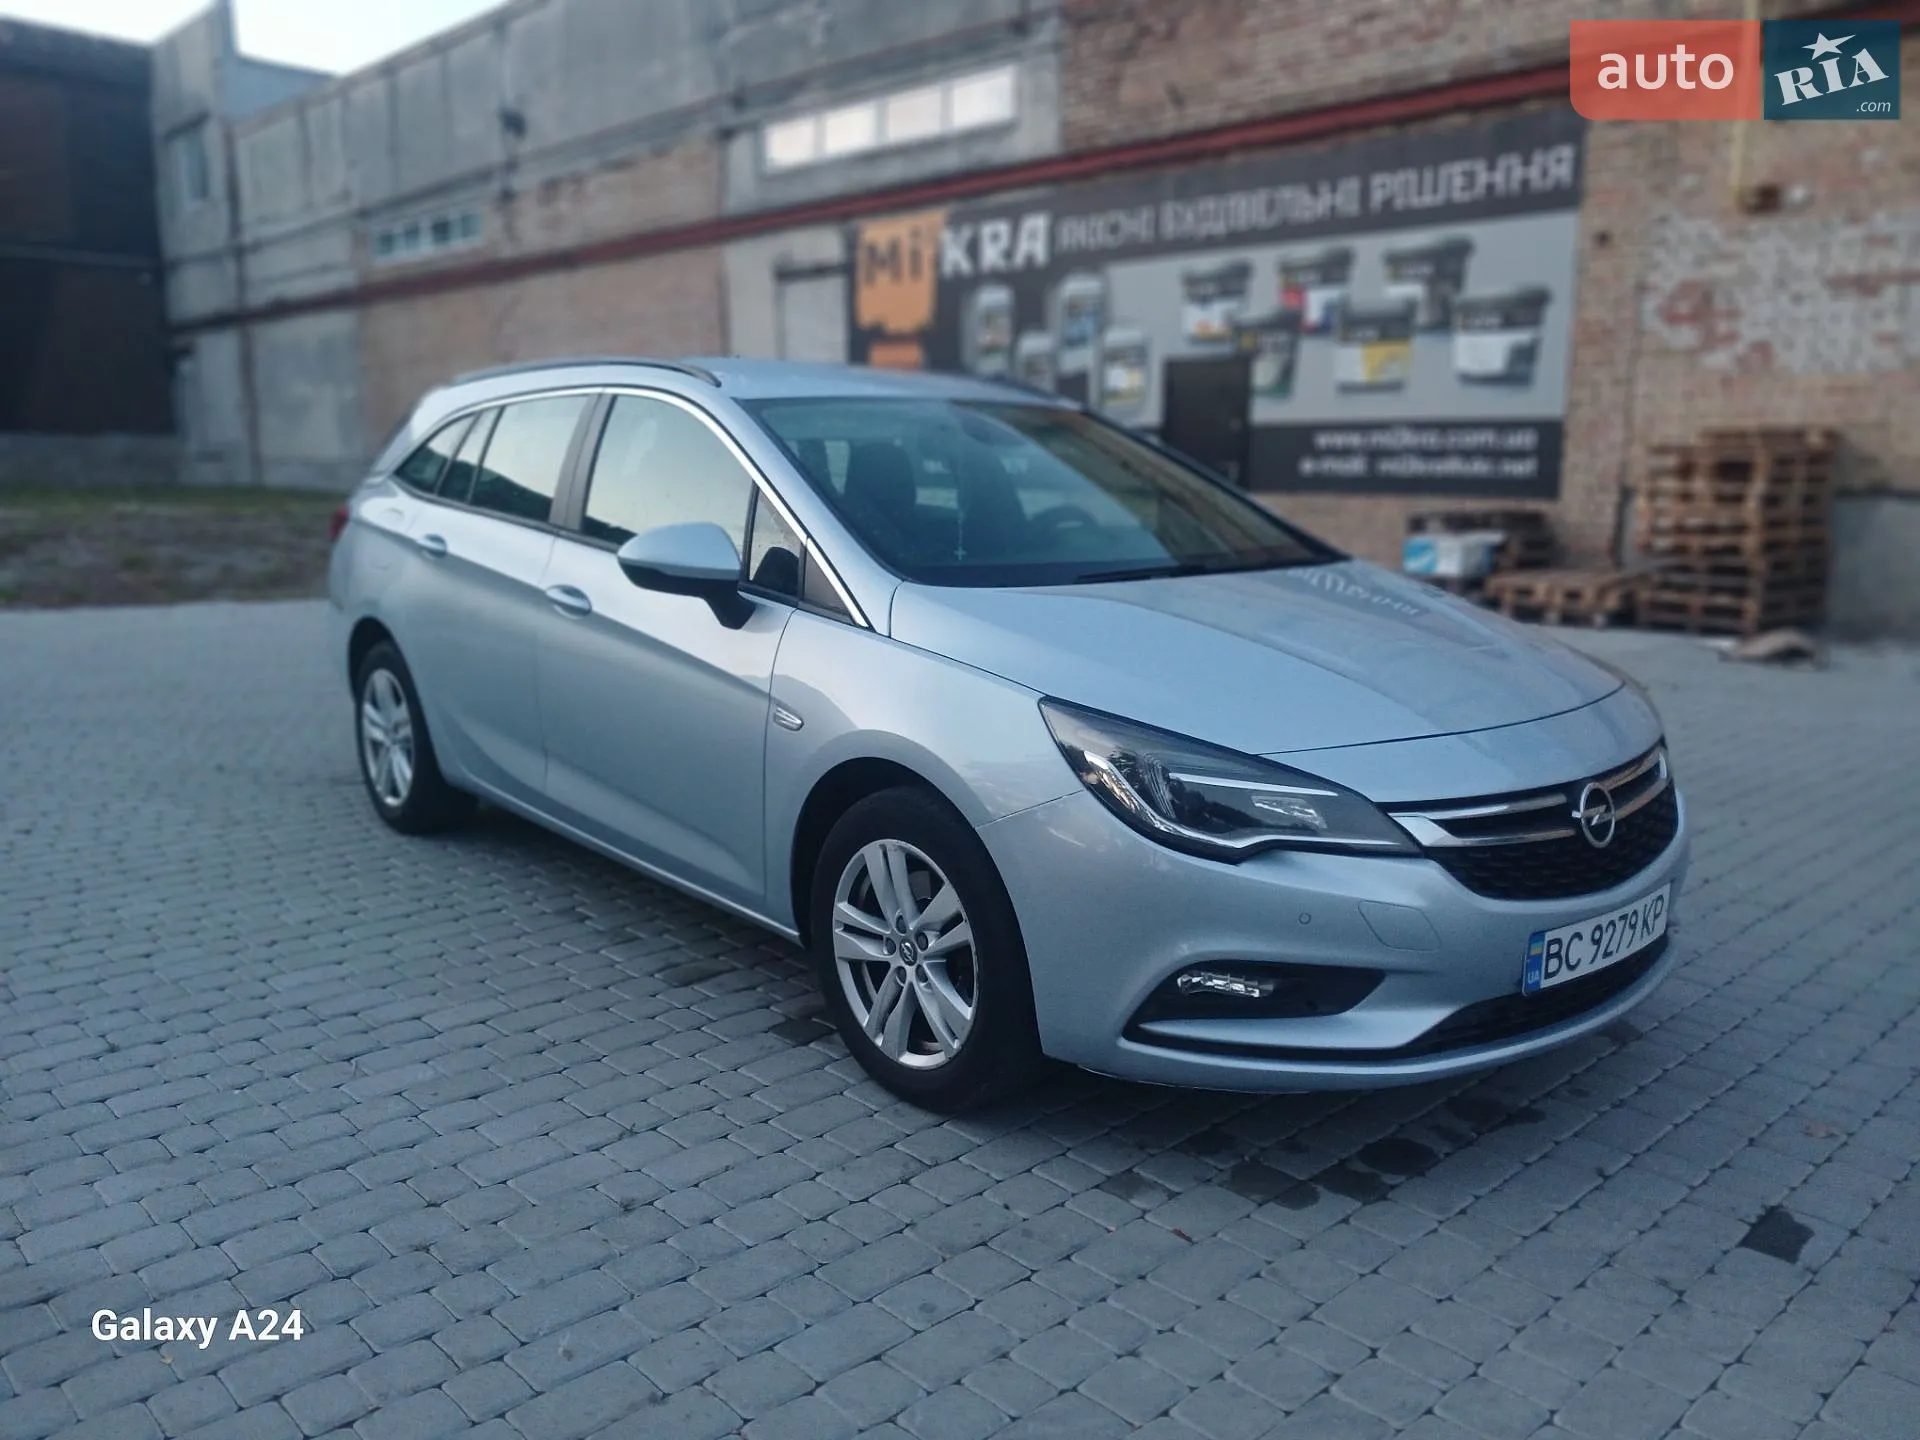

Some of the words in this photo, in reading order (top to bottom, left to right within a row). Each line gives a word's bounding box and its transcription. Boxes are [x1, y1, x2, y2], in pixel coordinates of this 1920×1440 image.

[1544, 932, 1583, 979] BC
[1589, 909, 1638, 964] 9279
[1640, 894, 1664, 939] KP
[1526, 970, 1541, 985] UA
